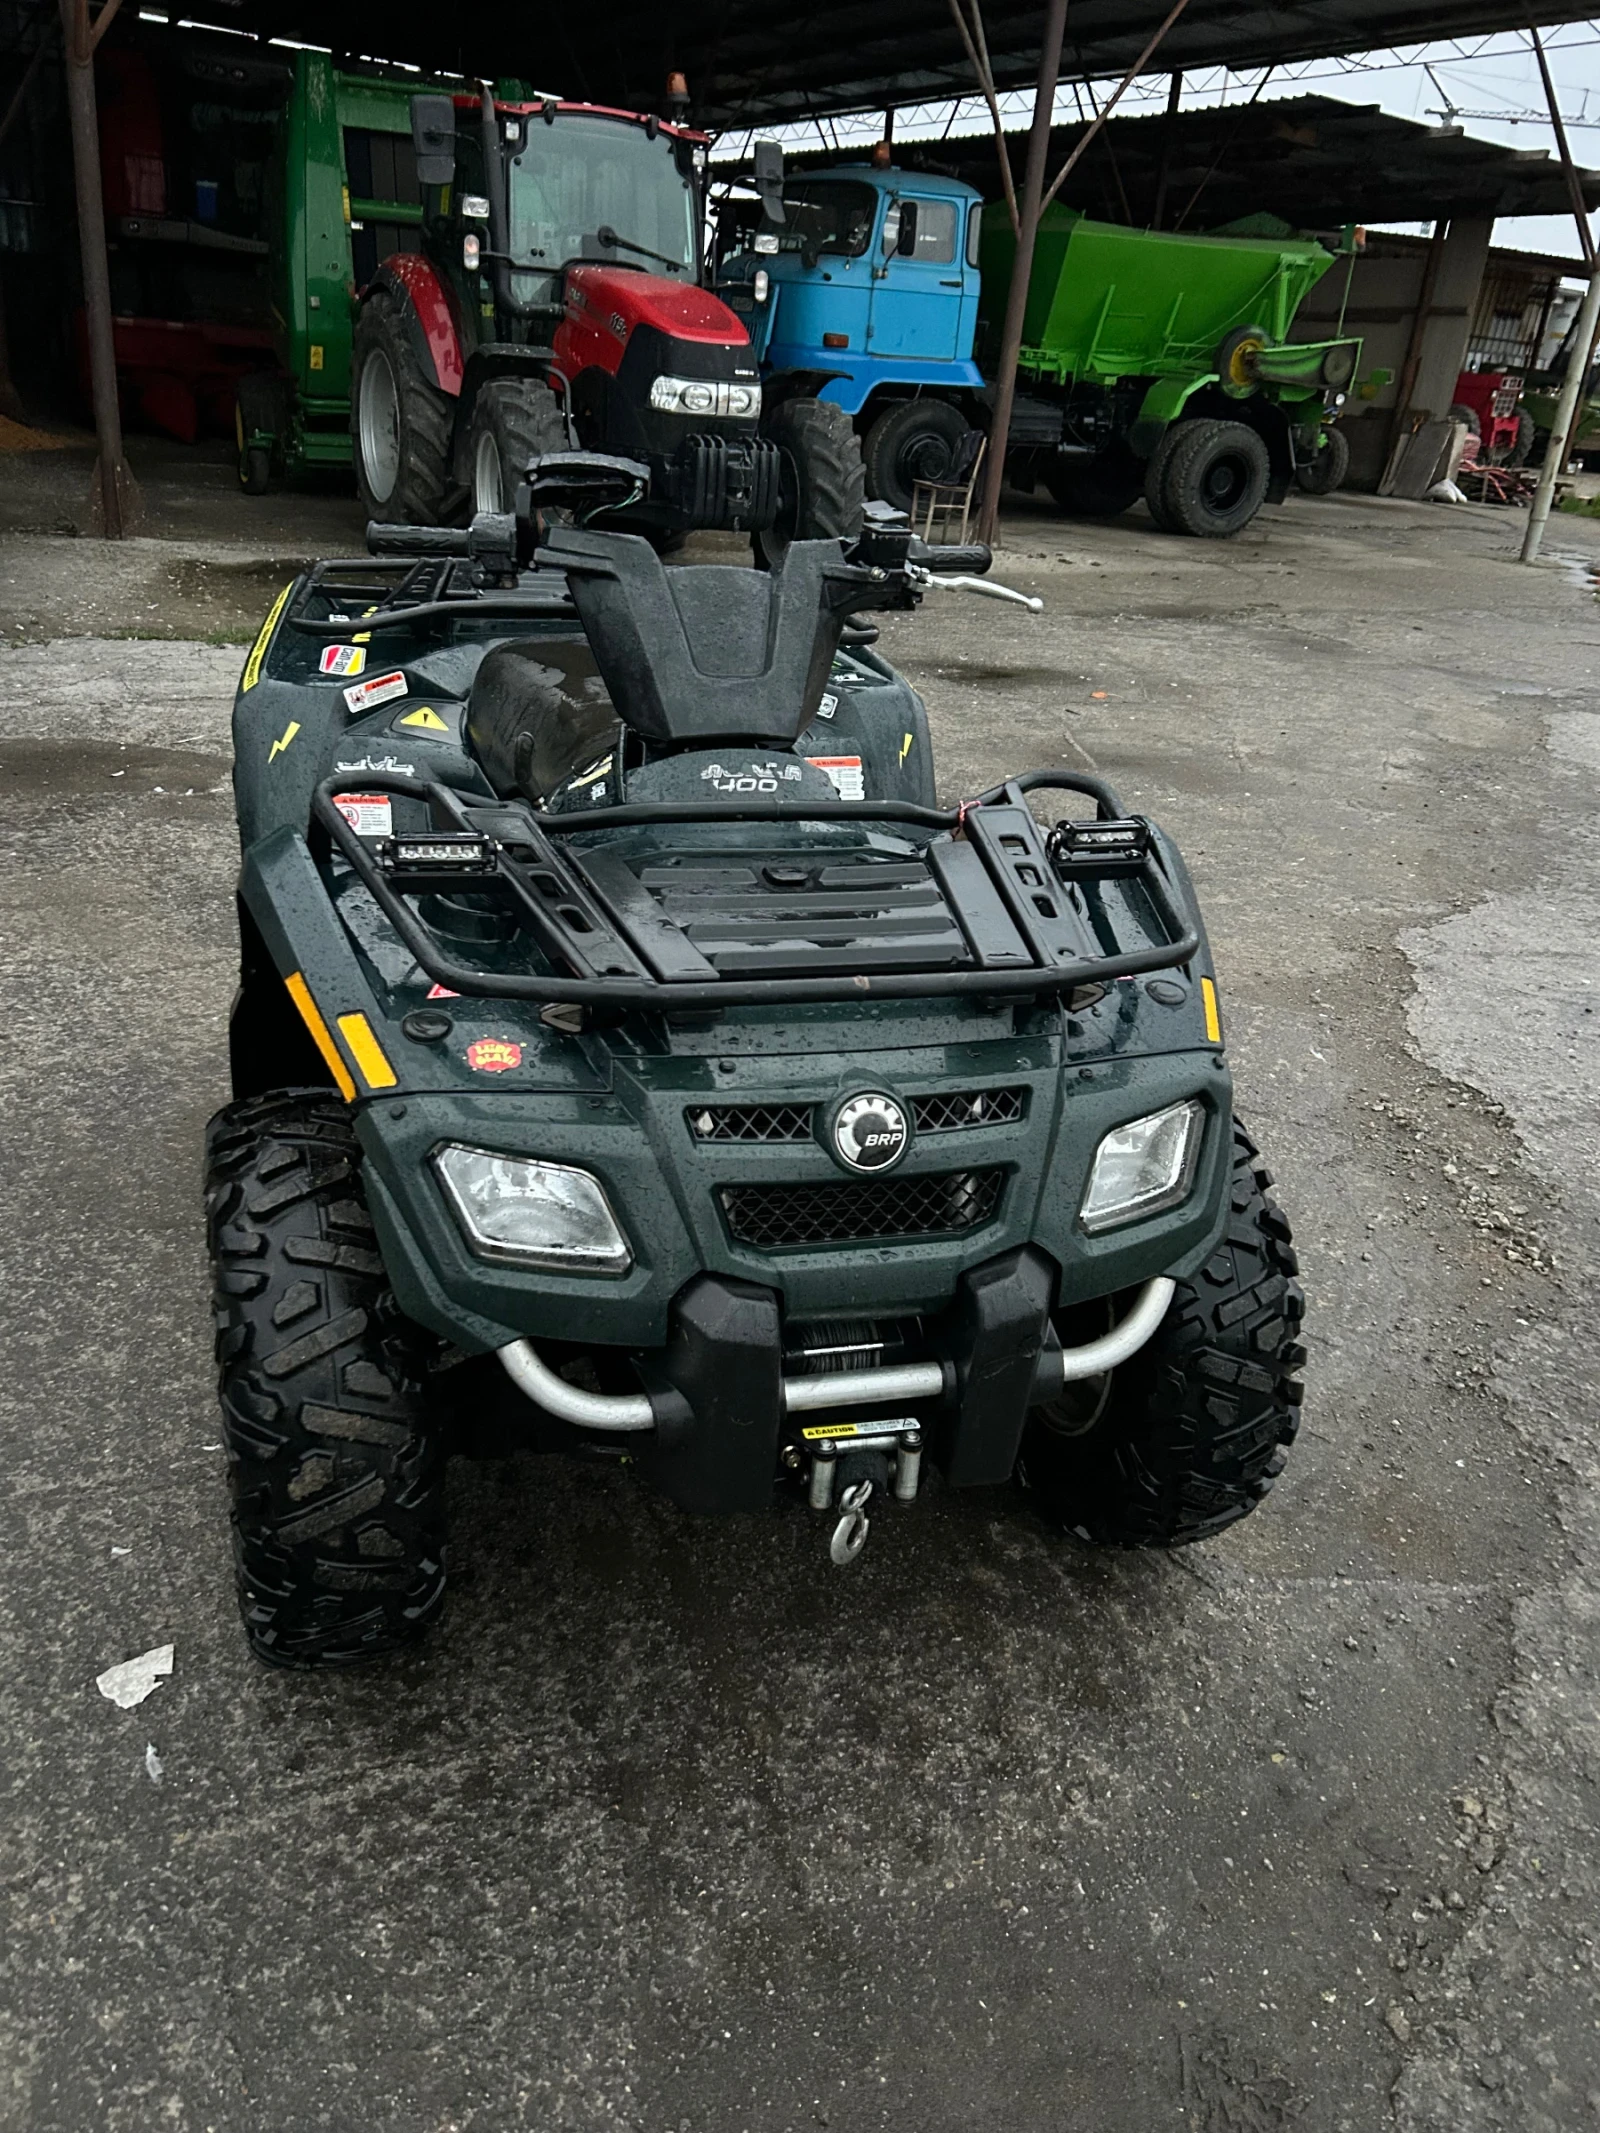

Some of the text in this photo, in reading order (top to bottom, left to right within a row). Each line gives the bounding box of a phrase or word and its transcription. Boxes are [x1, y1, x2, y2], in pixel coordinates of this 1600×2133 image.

[713, 778, 779, 793] 400
[864, 1132, 903, 1147] BRP
[815, 1425, 855, 1436] CAUTION
